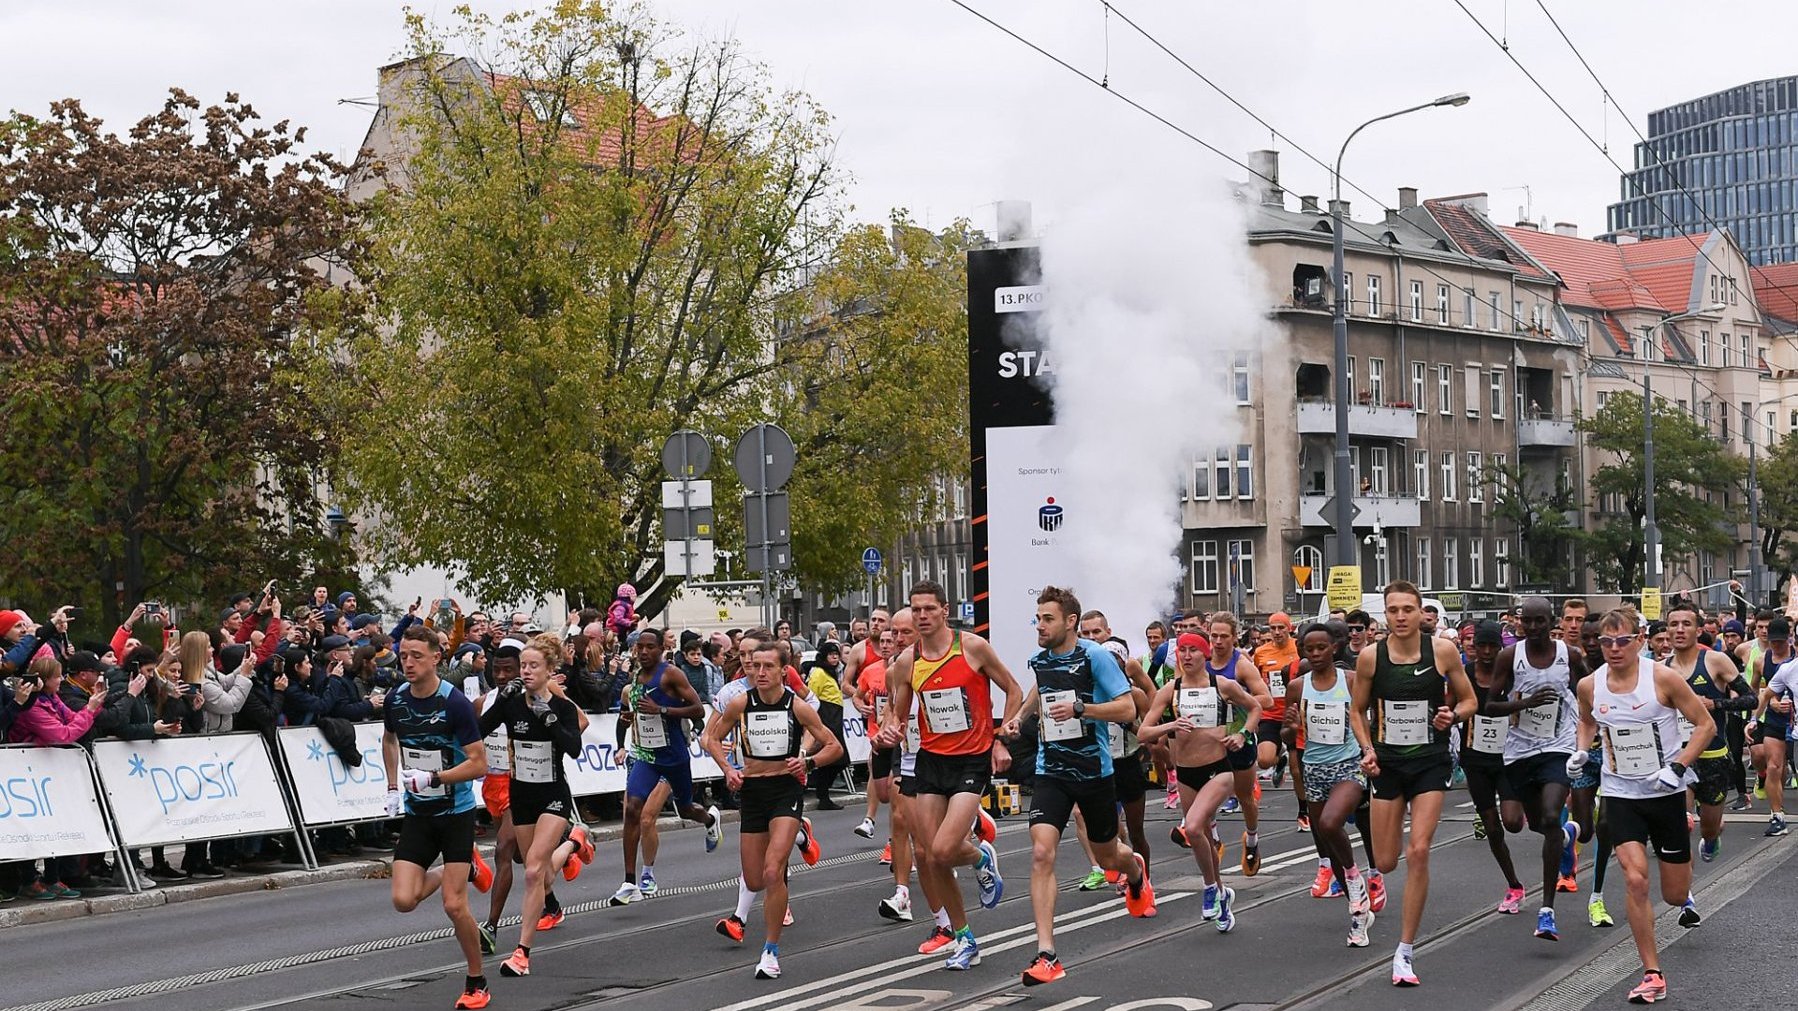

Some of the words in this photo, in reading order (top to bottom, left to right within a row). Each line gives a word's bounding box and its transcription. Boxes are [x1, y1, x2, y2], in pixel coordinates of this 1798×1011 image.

[998, 350, 1057, 378] STA
[1018, 467, 1048, 475] Sponsor
[1050, 467, 1062, 475] tyt
[1031, 538, 1049, 546] Bank
[1028, 588, 1041, 596] Org
[930, 704, 960, 714] Nowak
[1525, 708, 1552, 720] Maiyo
[1310, 715, 1340, 725] Gichia
[1386, 716, 1427, 725] Karbowiak
[748, 728, 788, 736] Nadolska
[1483, 729, 1497, 739] 23
[515, 754, 551, 764] Verbruggen
[151, 752, 237, 815] posir
